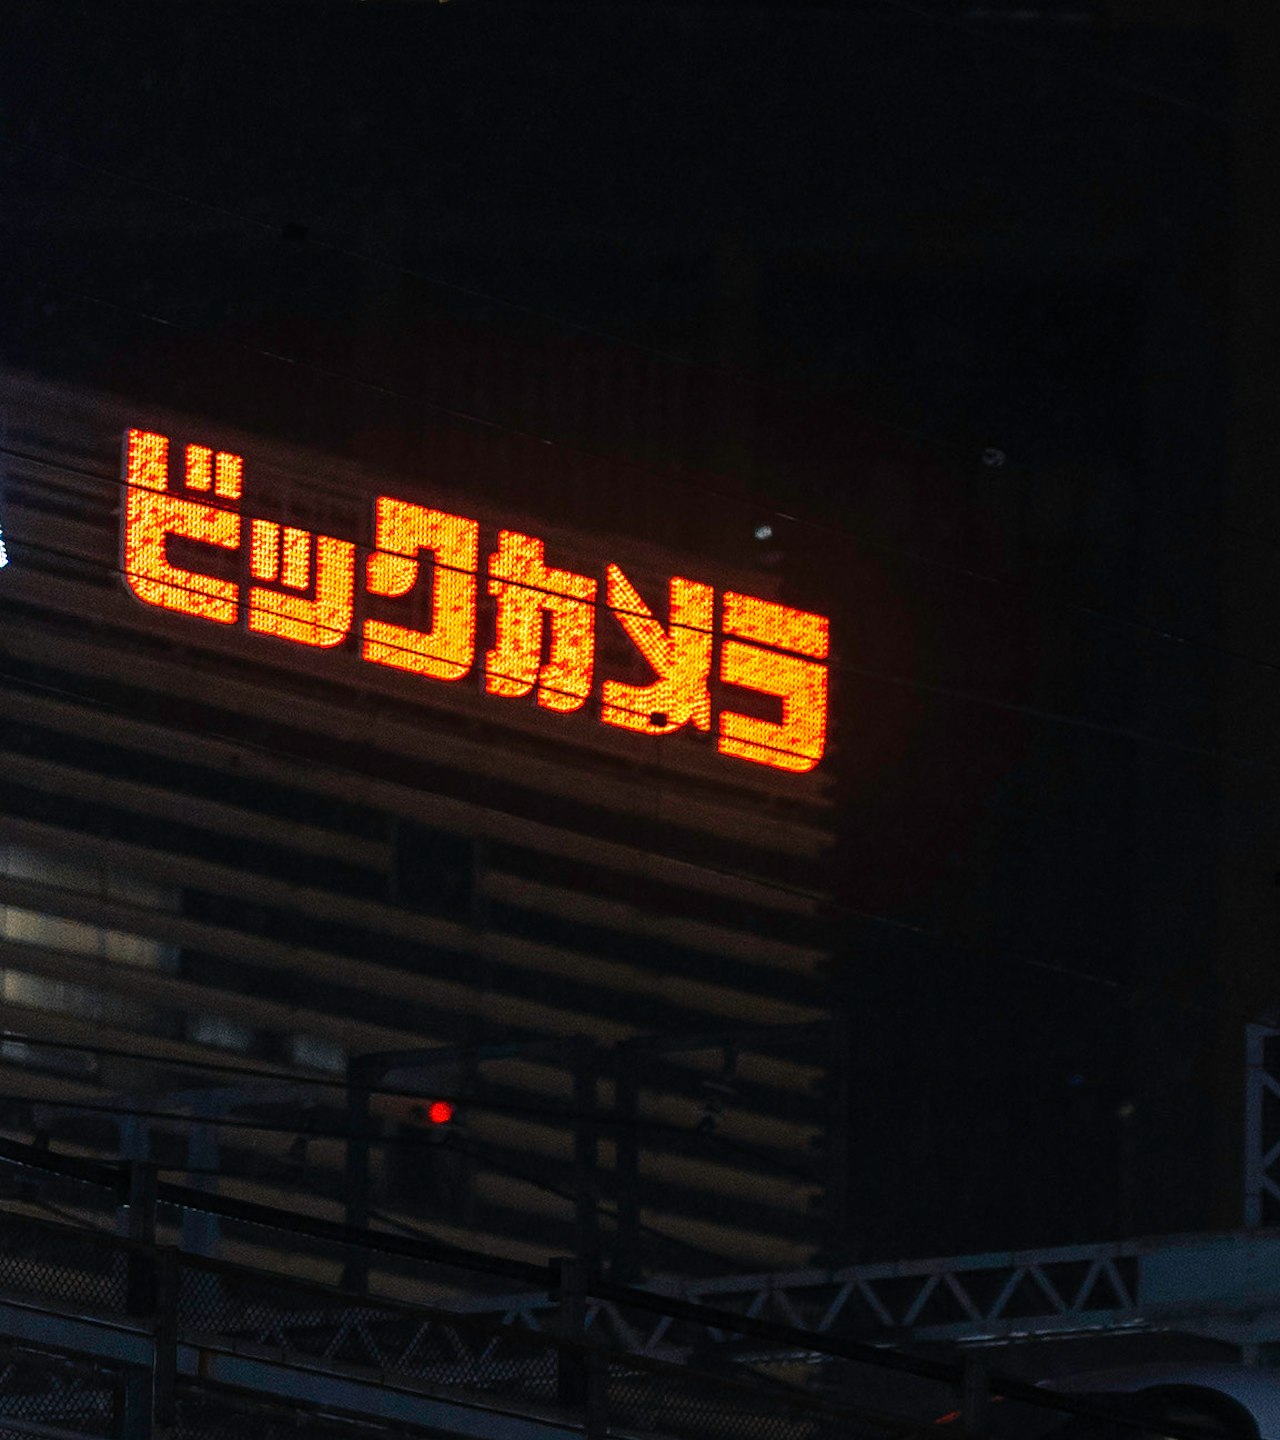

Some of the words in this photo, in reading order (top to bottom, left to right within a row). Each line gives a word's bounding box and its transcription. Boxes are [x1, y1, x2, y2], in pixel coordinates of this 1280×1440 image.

[124, 428, 829, 772] ビックカメラ
